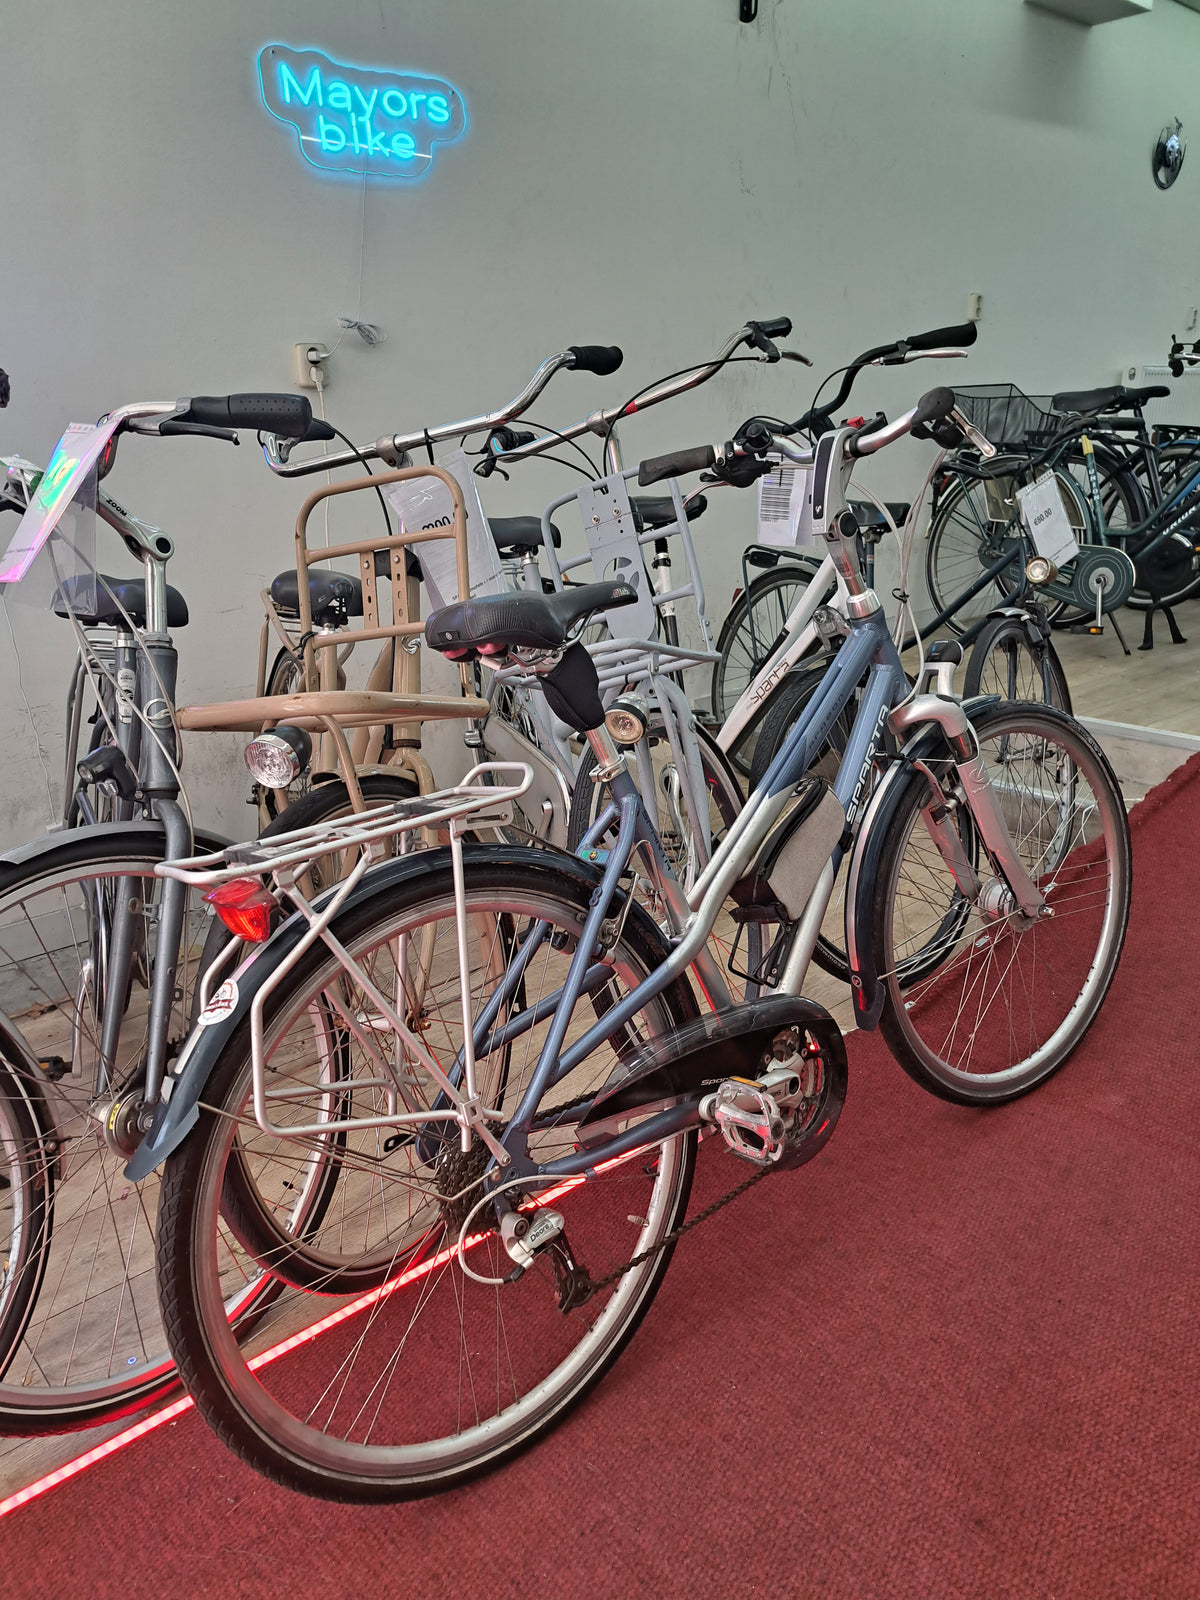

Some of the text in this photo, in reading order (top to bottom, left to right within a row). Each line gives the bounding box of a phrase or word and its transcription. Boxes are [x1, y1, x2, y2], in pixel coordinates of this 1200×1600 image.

[279, 63, 450, 122] Mayors
[318, 112, 416, 159] bike
[106, 498, 127, 517] ZOOM
[846, 704, 889, 824] SPARTA
[530, 1223, 550, 1242] Deore
